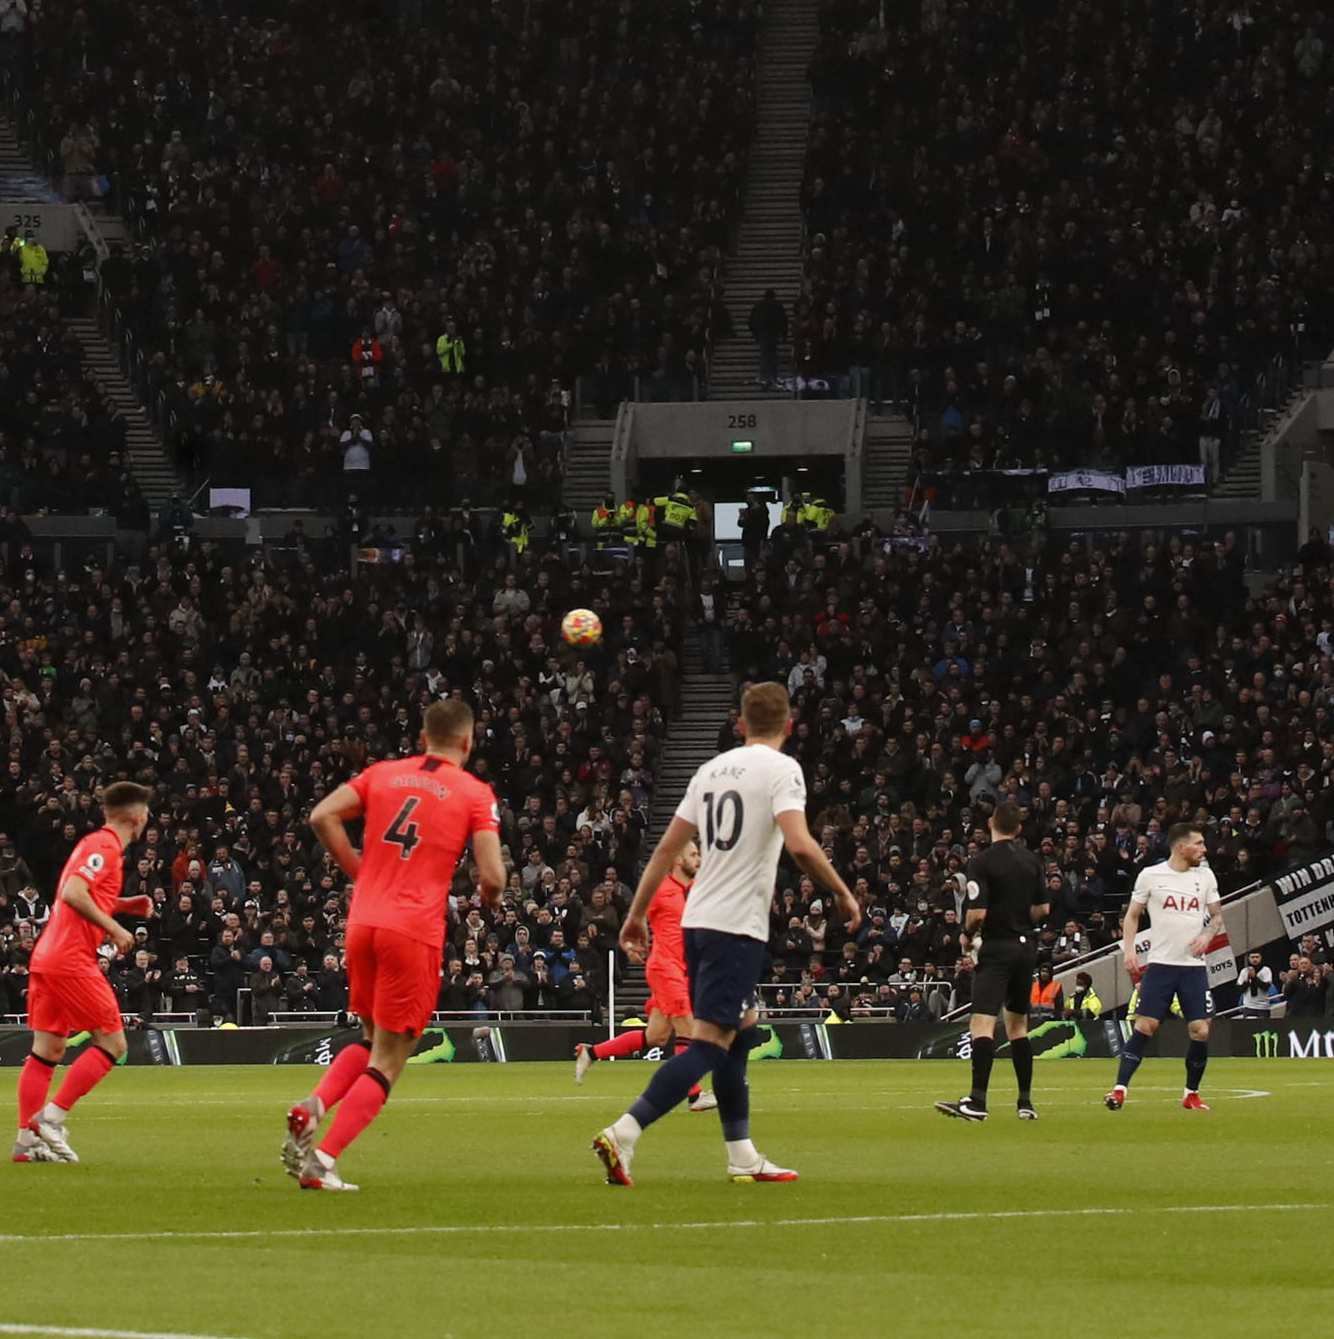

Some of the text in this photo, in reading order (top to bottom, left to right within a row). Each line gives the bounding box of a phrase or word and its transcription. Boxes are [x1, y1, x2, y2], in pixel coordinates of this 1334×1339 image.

[14, 214, 42, 228] 325
[728, 415, 757, 429] 258
[710, 766, 746, 780] KANE
[381, 795, 422, 860] 4
[703, 789, 744, 852] 10
[1275, 867, 1313, 896] WIN
[1162, 895, 1200, 912] AIA
[1210, 960, 1234, 975] BOYS
